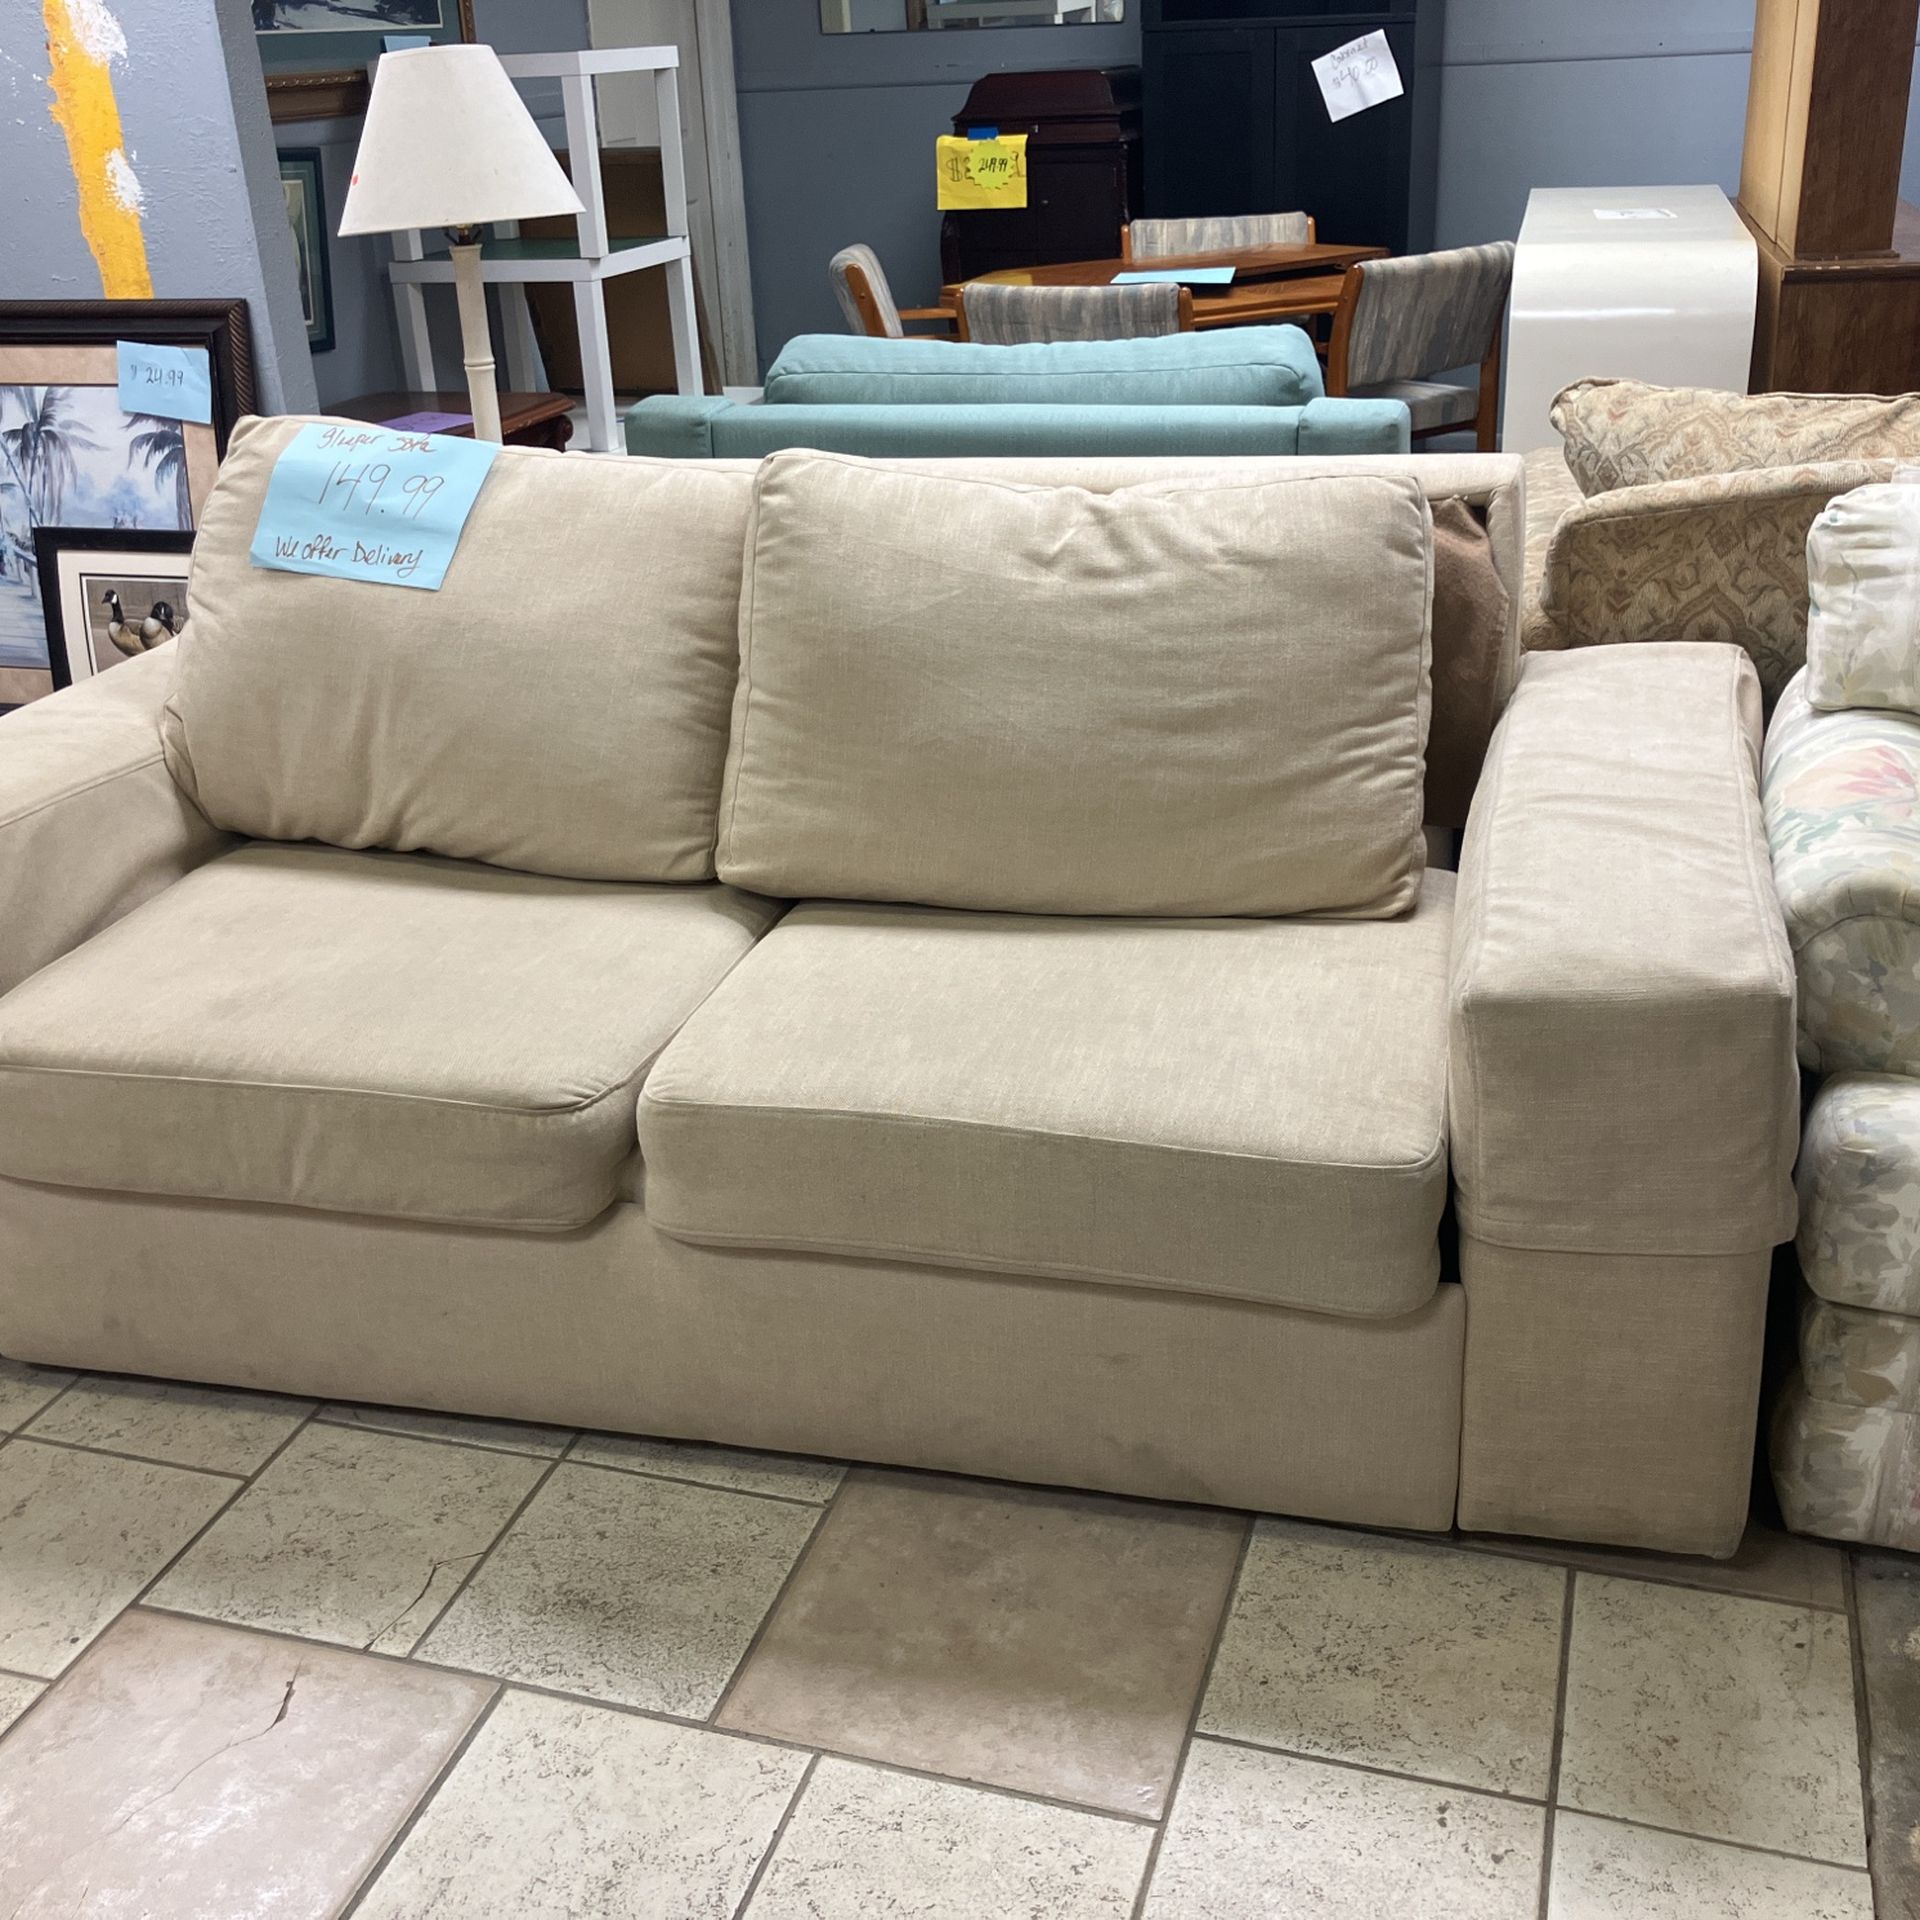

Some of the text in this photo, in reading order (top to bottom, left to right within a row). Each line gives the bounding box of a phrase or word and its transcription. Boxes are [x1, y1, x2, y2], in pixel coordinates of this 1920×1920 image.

[318, 460, 445, 520] 149.99
[275, 535, 299, 559] We
[351, 540, 423, 578] Delivery
